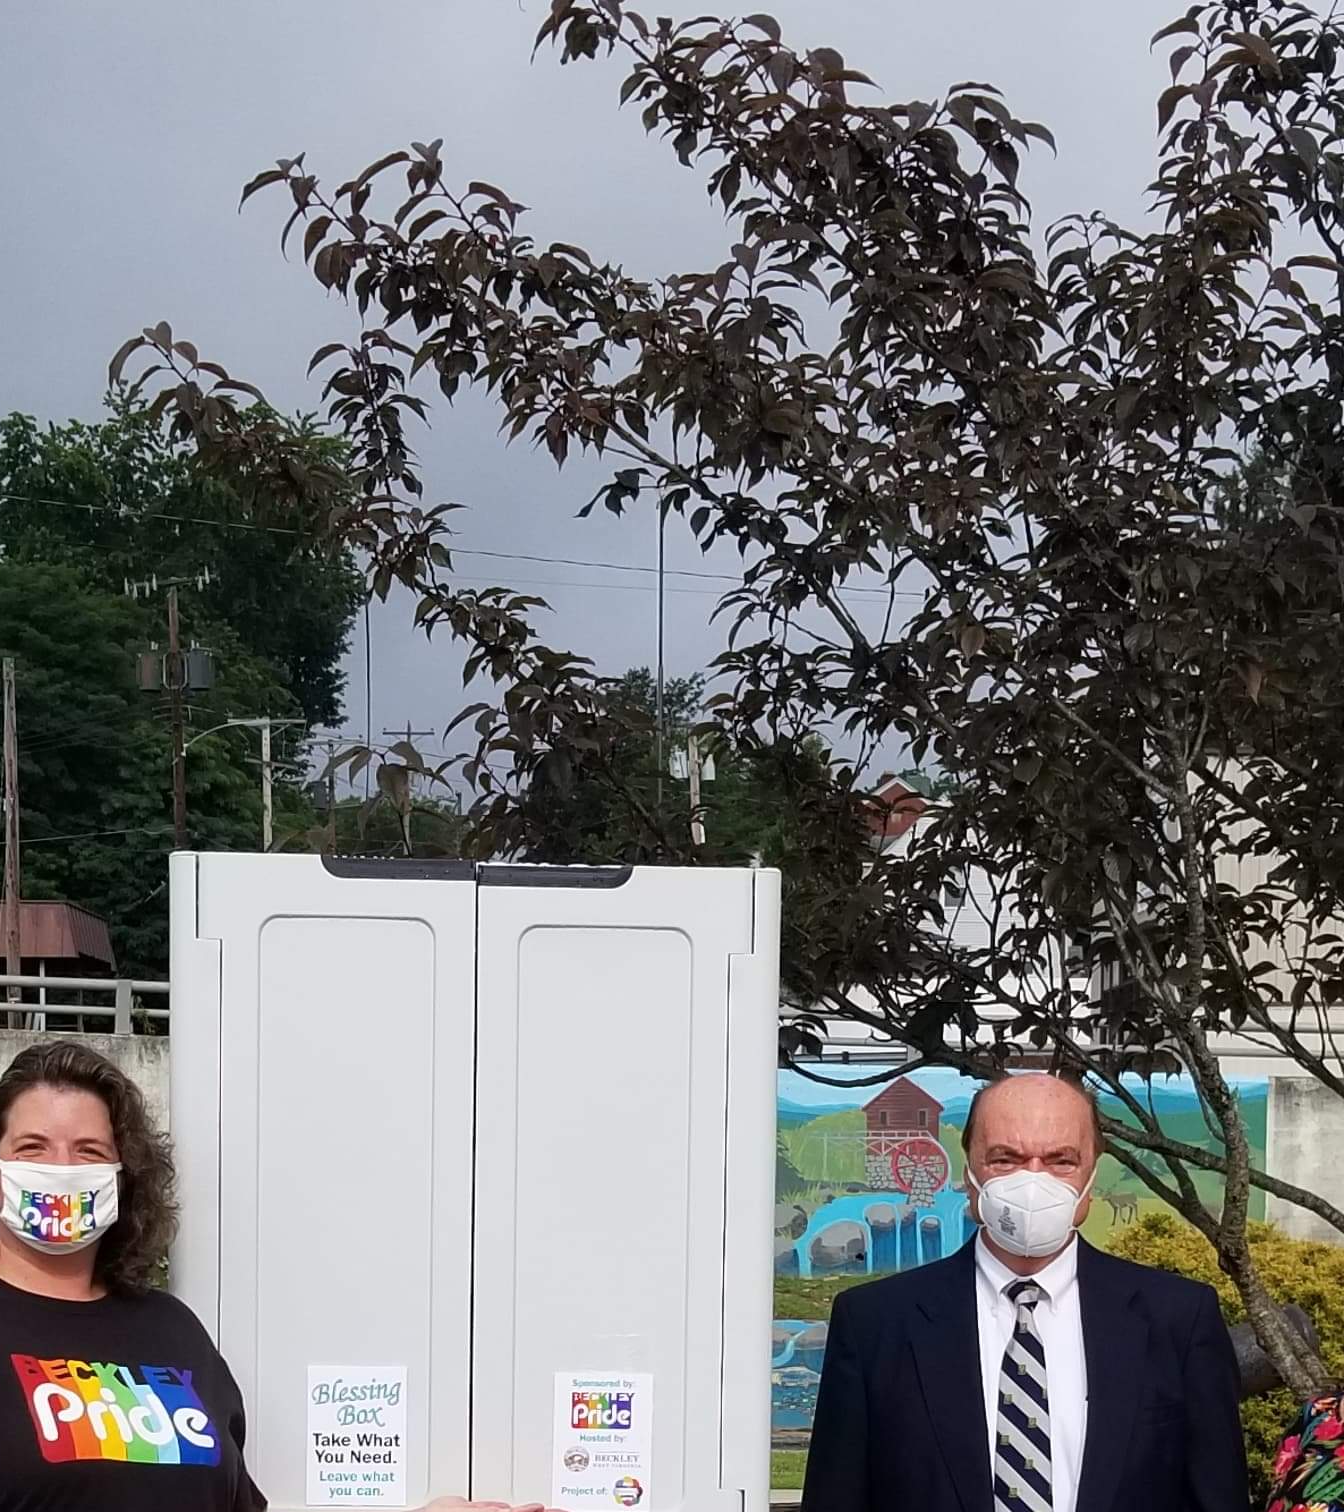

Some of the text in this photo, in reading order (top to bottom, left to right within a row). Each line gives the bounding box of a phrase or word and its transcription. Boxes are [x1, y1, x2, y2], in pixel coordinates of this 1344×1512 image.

[21, 1190, 100, 1206] BECKLEY
[21, 1206, 95, 1237] Pride
[12, 1354, 193, 1388] BECKLEY
[312, 1378, 402, 1406] Blessing
[572, 1391, 635, 1402] BECKLEY
[33, 1382, 215, 1449] Pride
[337, 1405, 386, 1428] Box
[573, 1403, 631, 1425] Pride
[313, 1433, 401, 1447] Take What
[580, 1434, 612, 1442] Hosted
[315, 1450, 397, 1464] You Need.
[594, 1454, 640, 1463] BECKLEY
[320, 1471, 395, 1482] Leave what
[329, 1487, 384, 1498] you can.
[561, 1487, 594, 1497] Project
[596, 1487, 608, 1495] of:
